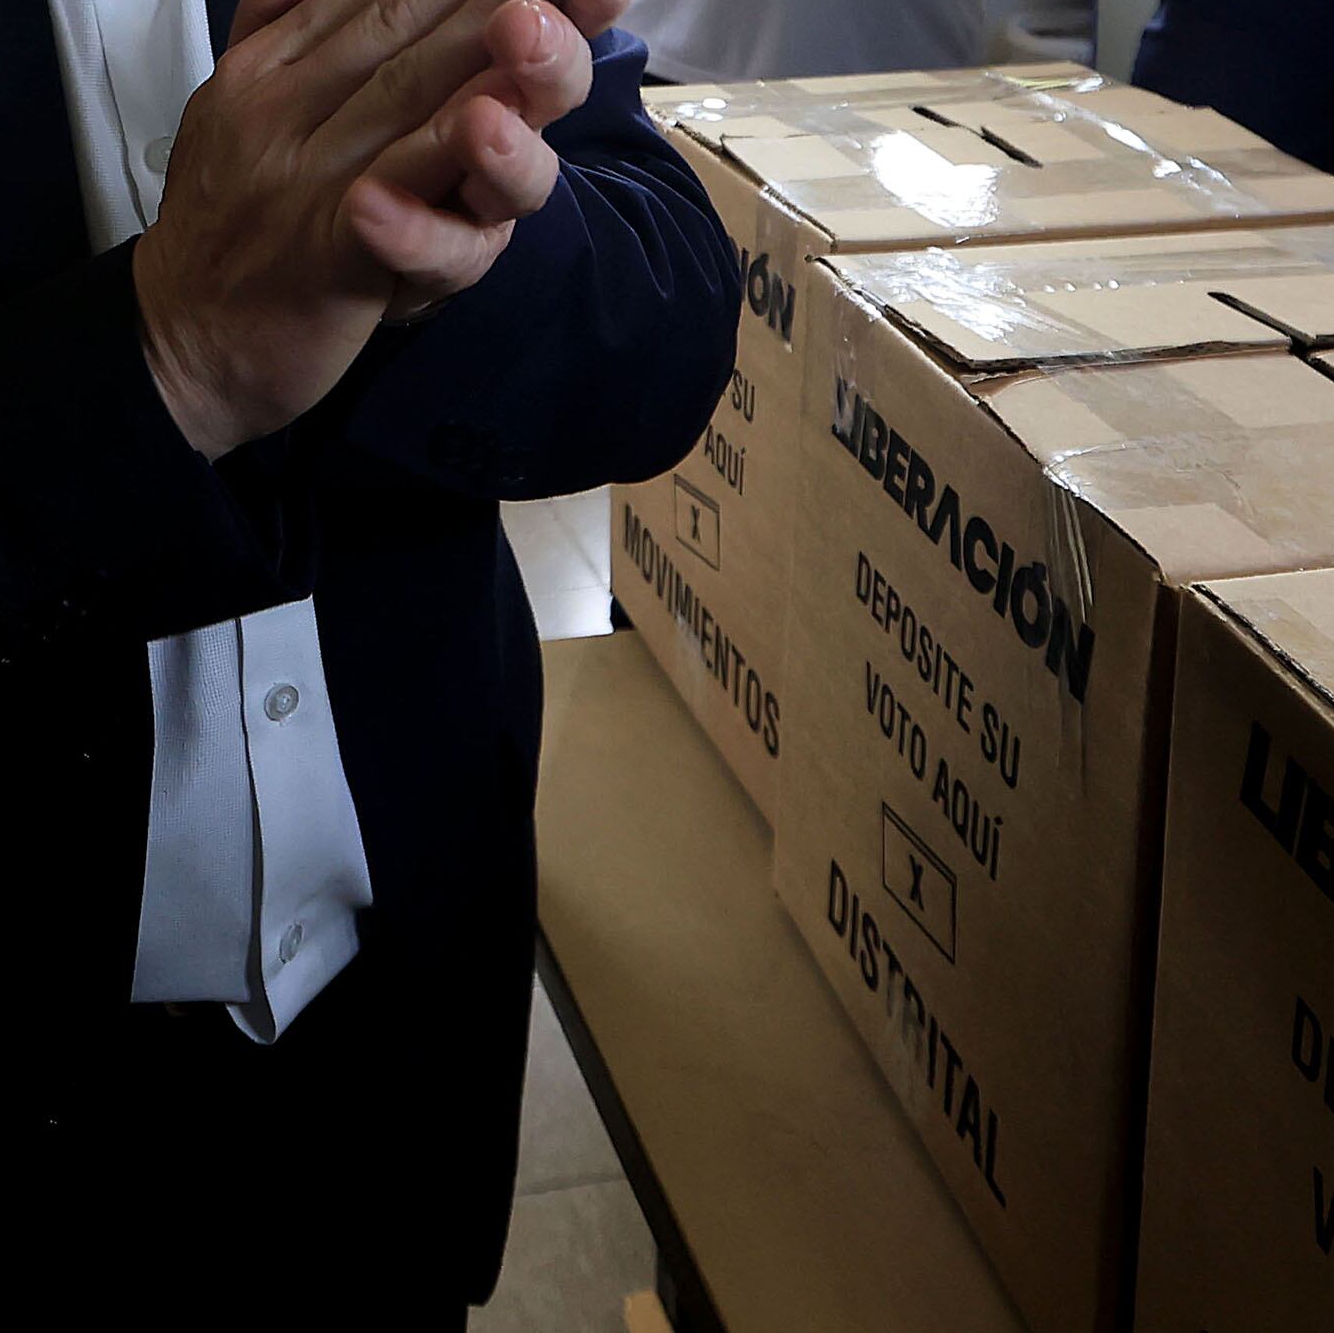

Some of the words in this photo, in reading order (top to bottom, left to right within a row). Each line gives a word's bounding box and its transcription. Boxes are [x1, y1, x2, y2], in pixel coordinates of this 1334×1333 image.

[704, 424, 745, 495] AQUÍ
[732, 371, 755, 423] SU
[623, 502, 780, 757] MOVIMIENTOS
[832, 376, 1095, 704] LIBERACIÓN
[856, 551, 972, 734] DEPOSITE
[980, 704, 1020, 790] SU
[866, 661, 927, 783] VOTO
[932, 758, 1002, 881] AQUÍ
[829, 859, 1007, 1208] DISTRITAL
